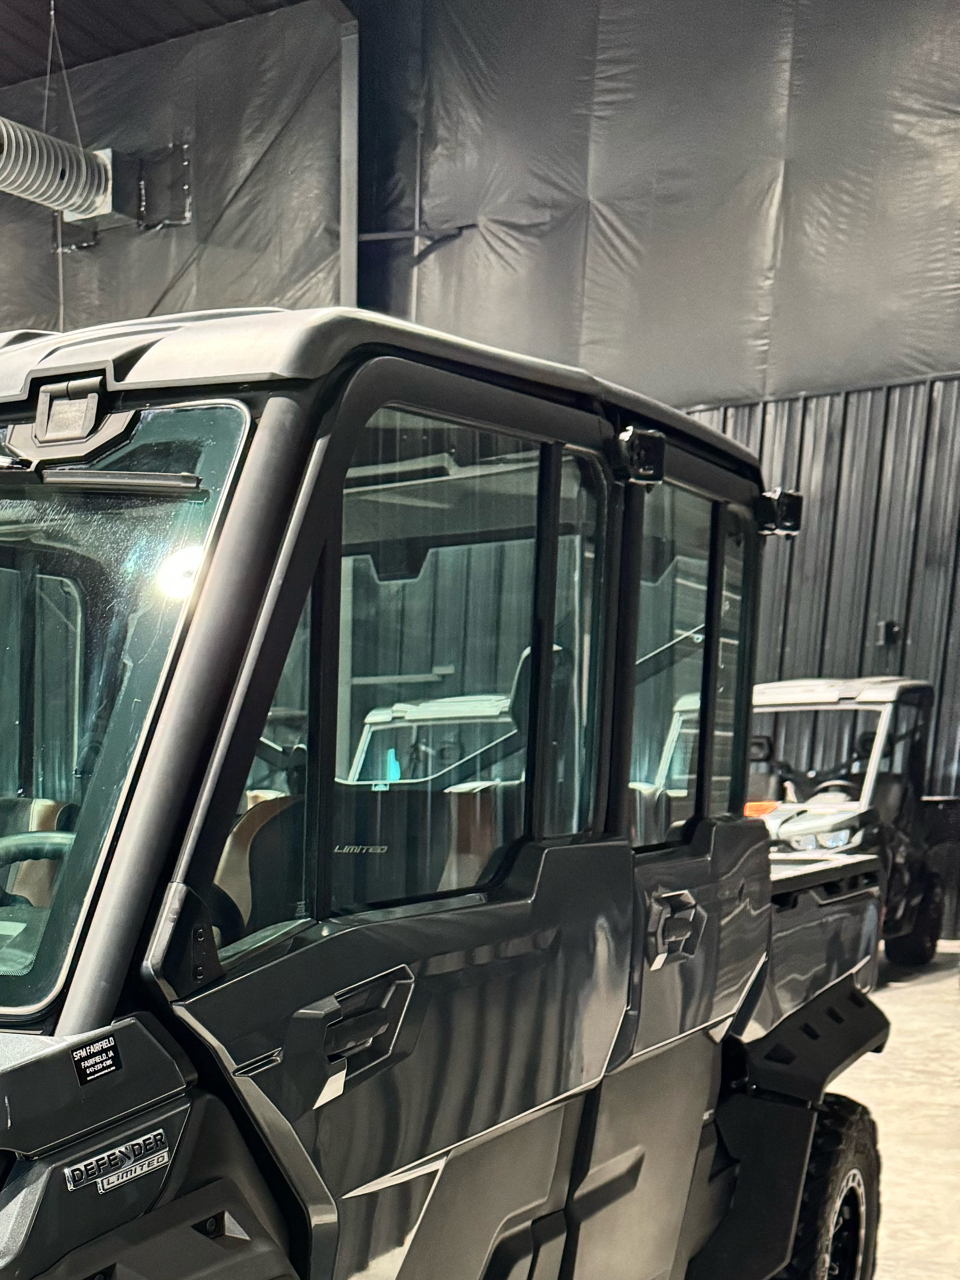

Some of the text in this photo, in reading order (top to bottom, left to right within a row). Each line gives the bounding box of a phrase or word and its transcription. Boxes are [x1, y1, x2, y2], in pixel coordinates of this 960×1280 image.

[333, 844, 388, 854] LIMITED
[86, 1036, 115, 1056] FAIRFIELD
[70, 1132, 166, 1184] DEFENDER
[105, 1155, 166, 1187] LIMITED
